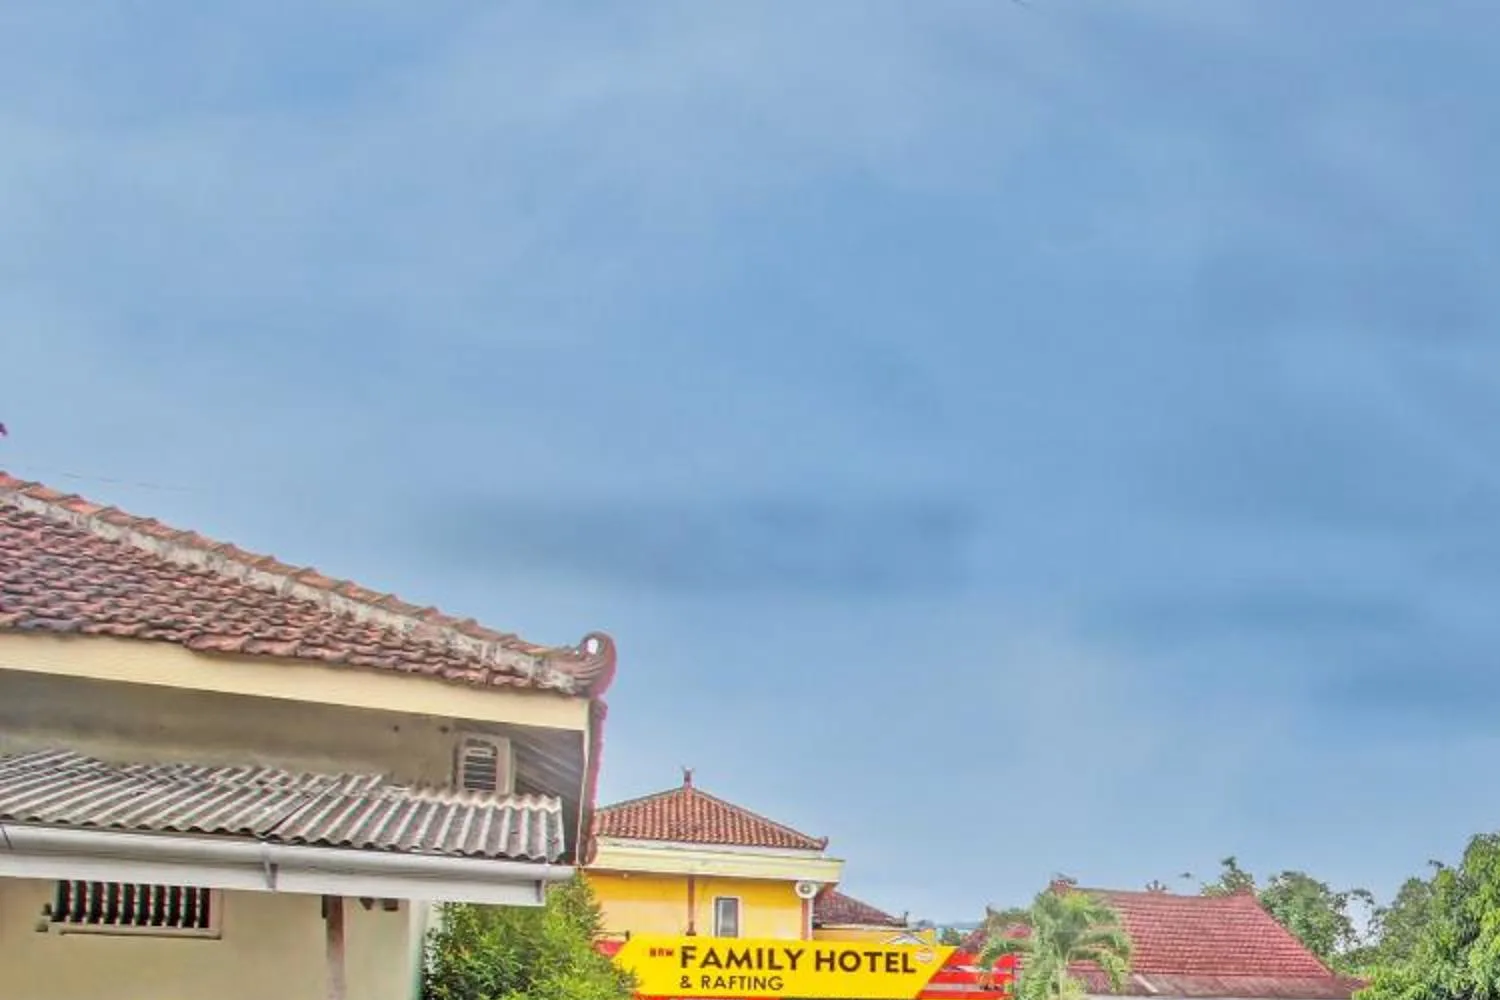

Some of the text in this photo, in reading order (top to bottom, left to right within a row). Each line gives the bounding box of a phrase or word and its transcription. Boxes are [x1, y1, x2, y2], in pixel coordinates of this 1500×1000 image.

[681, 945, 805, 971] FAMILY
[815, 949, 917, 973] HOTEL
[680, 975, 784, 991] & RAFTING
